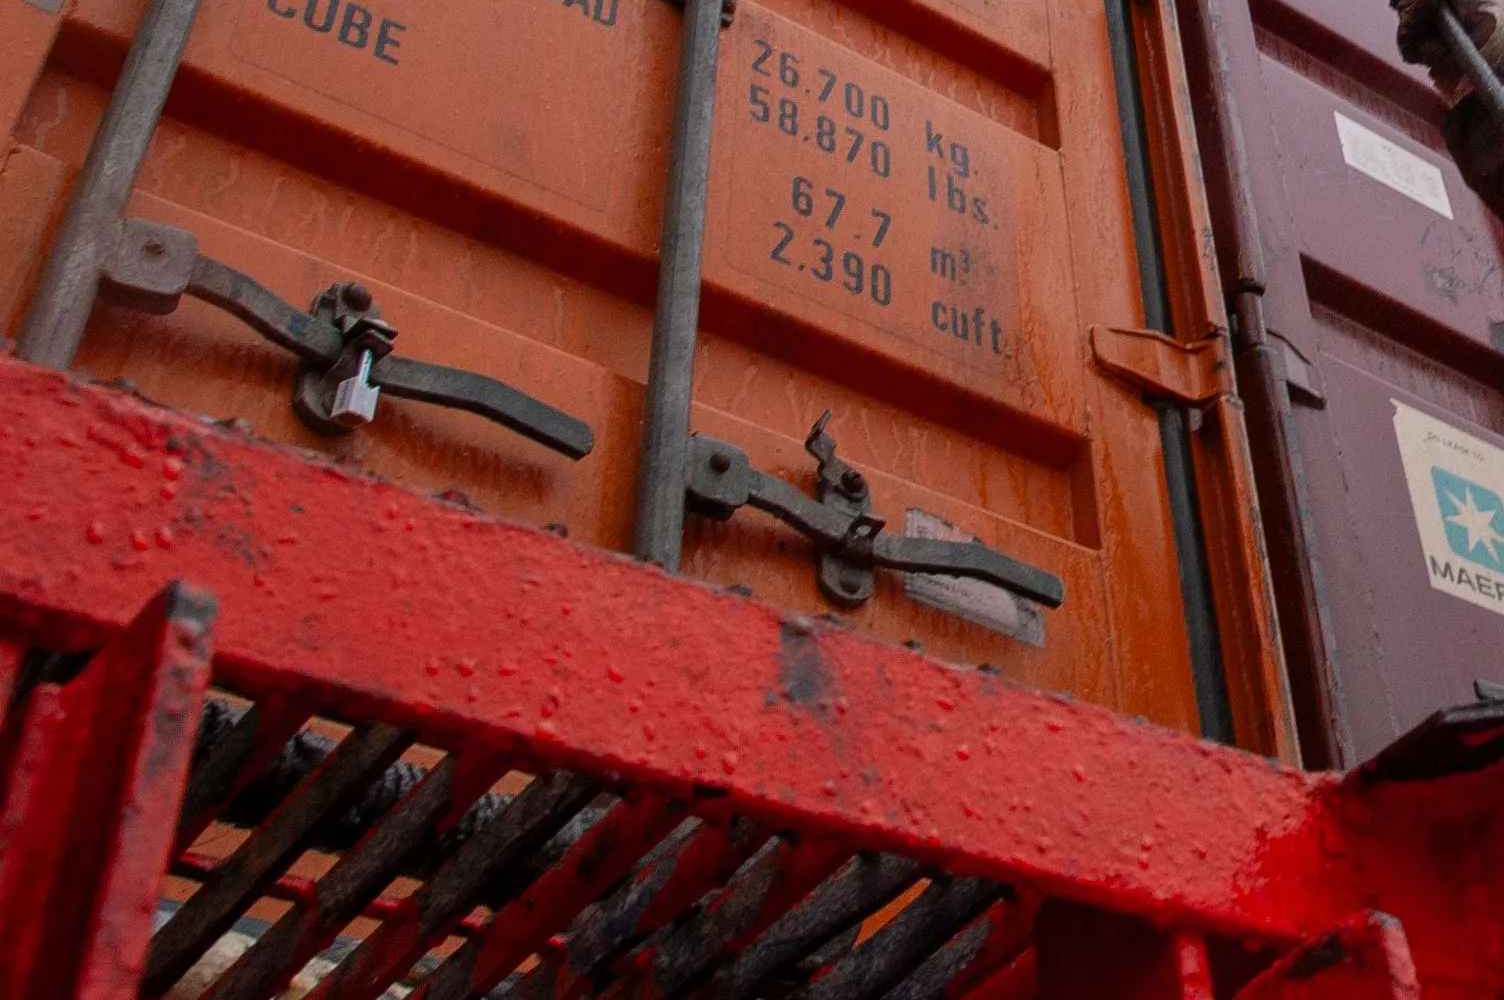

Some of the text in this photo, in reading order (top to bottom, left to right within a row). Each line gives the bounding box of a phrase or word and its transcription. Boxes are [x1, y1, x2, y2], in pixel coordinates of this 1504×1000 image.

[751, 39, 890, 131] 26.700
[750, 83, 891, 178] 58.870
[791, 176, 892, 248] 67.7
[769, 222, 892, 307] 2.390
